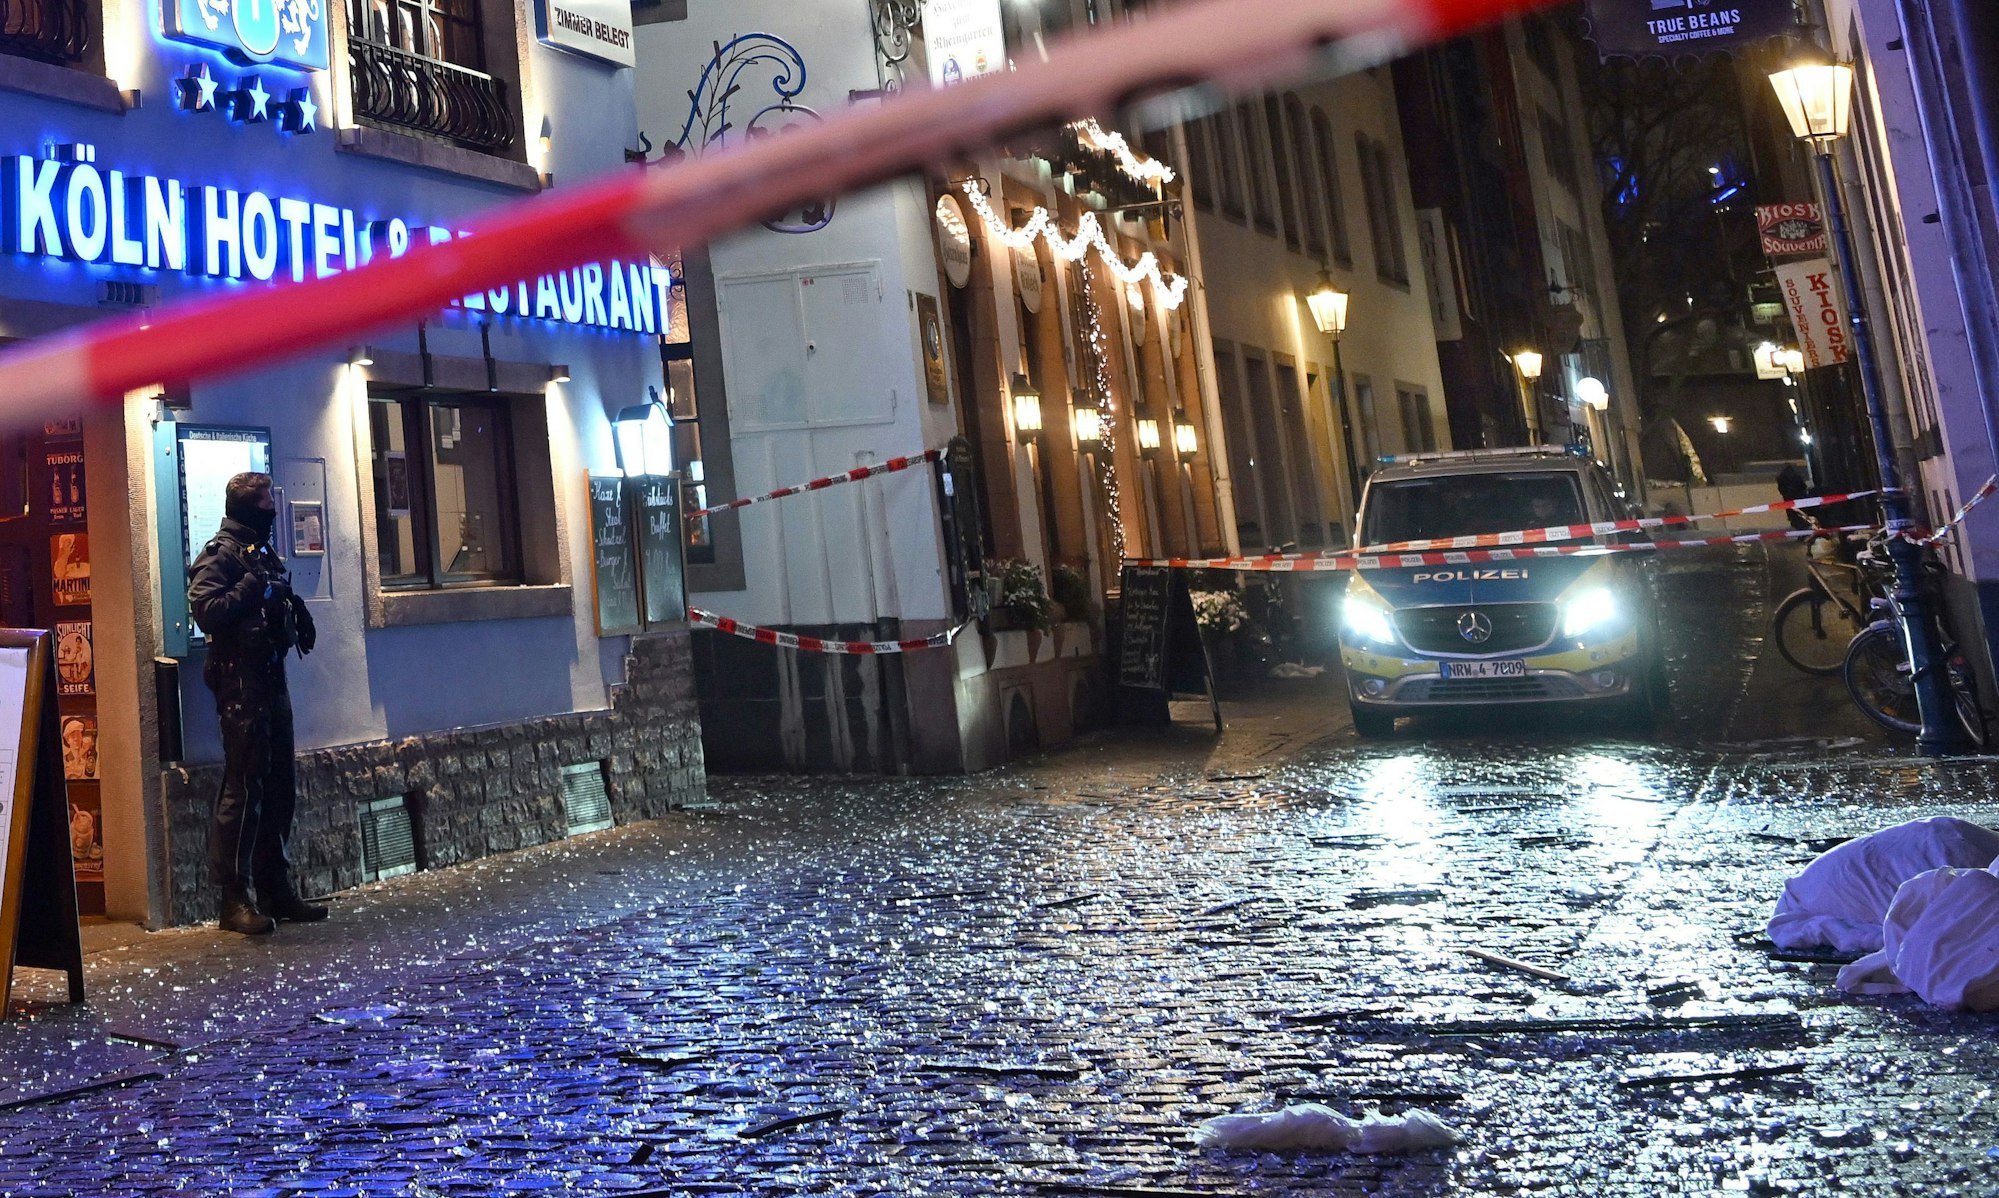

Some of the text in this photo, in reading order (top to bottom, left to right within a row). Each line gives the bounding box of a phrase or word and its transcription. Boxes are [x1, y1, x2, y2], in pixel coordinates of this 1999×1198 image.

[555, 7, 630, 49] ZIMMER BELEGT
[1647, 9, 1740, 34] TRUE BEANS
[1658, 32, 1689, 44] SPECIALTY
[1689, 29, 1712, 39] COFFEE
[1717, 26, 1735, 36] MORE
[19, 143, 184, 271] KÖLN
[1758, 203, 1820, 226] KIOSK
[1805, 272, 1848, 362] KIOSK
[189, 430, 257, 443] Deutsche & Italienische Küche
[46, 455, 84, 466] TUBORG
[650, 511, 672, 541] Buffet
[53, 577, 90, 593] MARTINI
[1413, 569, 1529, 584] POLIZEI
[56, 622, 92, 643] SUNLIGHT
[1447, 663, 1472, 677] NRW
[63, 683, 89, 693] SEIFE
